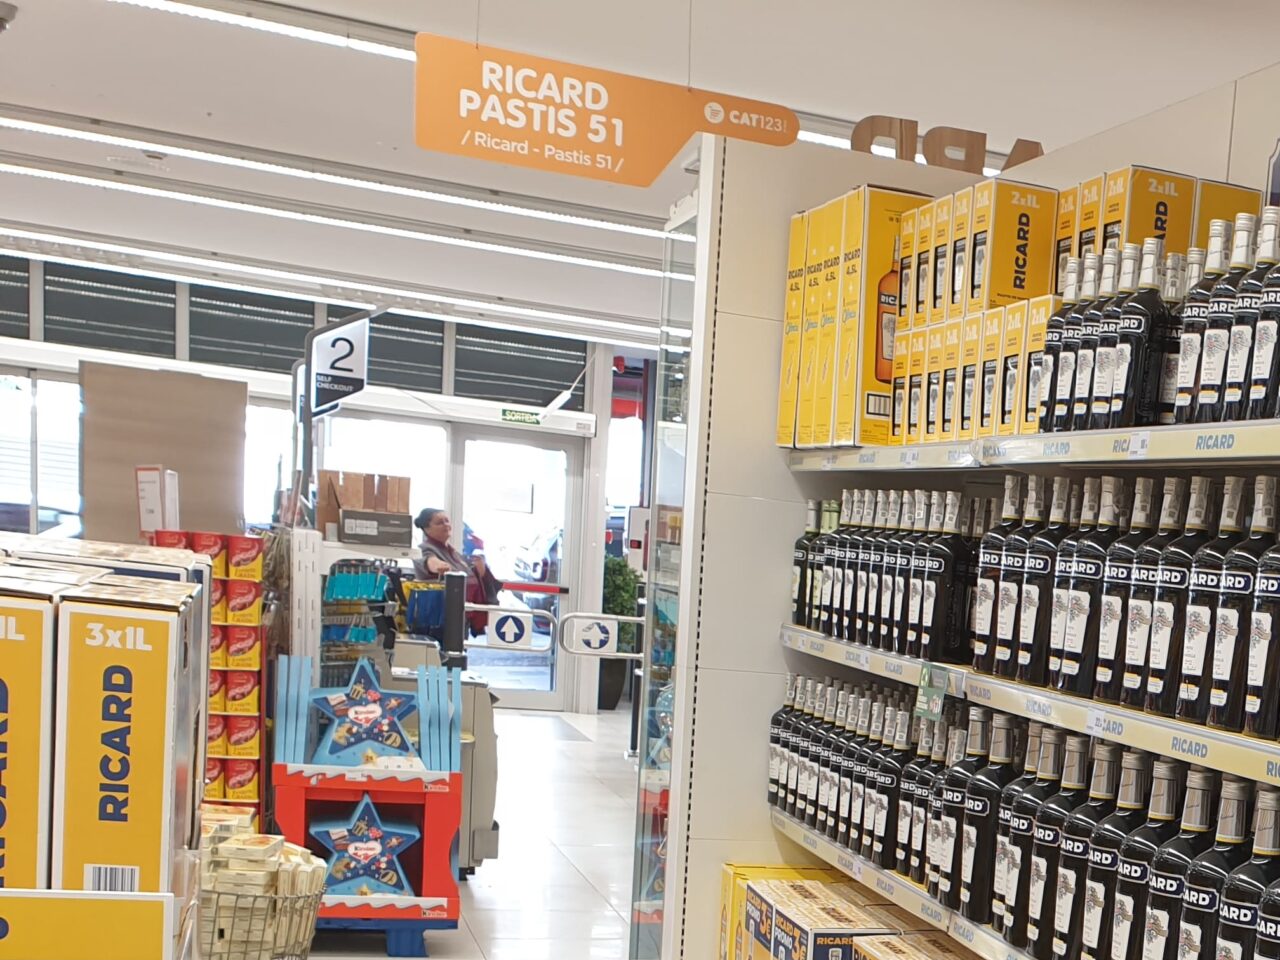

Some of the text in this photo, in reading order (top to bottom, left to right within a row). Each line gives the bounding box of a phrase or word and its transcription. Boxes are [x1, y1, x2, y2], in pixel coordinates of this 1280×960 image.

[481, 60, 608, 111] RICARD
[459, 88, 624, 147] PASTIS 51
[474, 131, 592, 167] Ricard Pastis
[1148, 178, 1178, 198] 2x1L
[1010, 191, 1040, 209] 2x1L
[1013, 212, 1031, 290] RICARD
[330, 337, 354, 372] 2
[317, 382, 354, 391] CHECKOUT
[505, 410, 537, 423] SORTIDA
[1195, 433, 1235, 451] RICARD
[85, 622, 152, 651] 3x1L
[98, 664, 133, 822] RICARD
[1171, 736, 1208, 758] RICARD
[921, 903, 942, 922] RICARD
[775, 926, 792, 949] PROMO
[952, 921, 974, 944] RICARD
